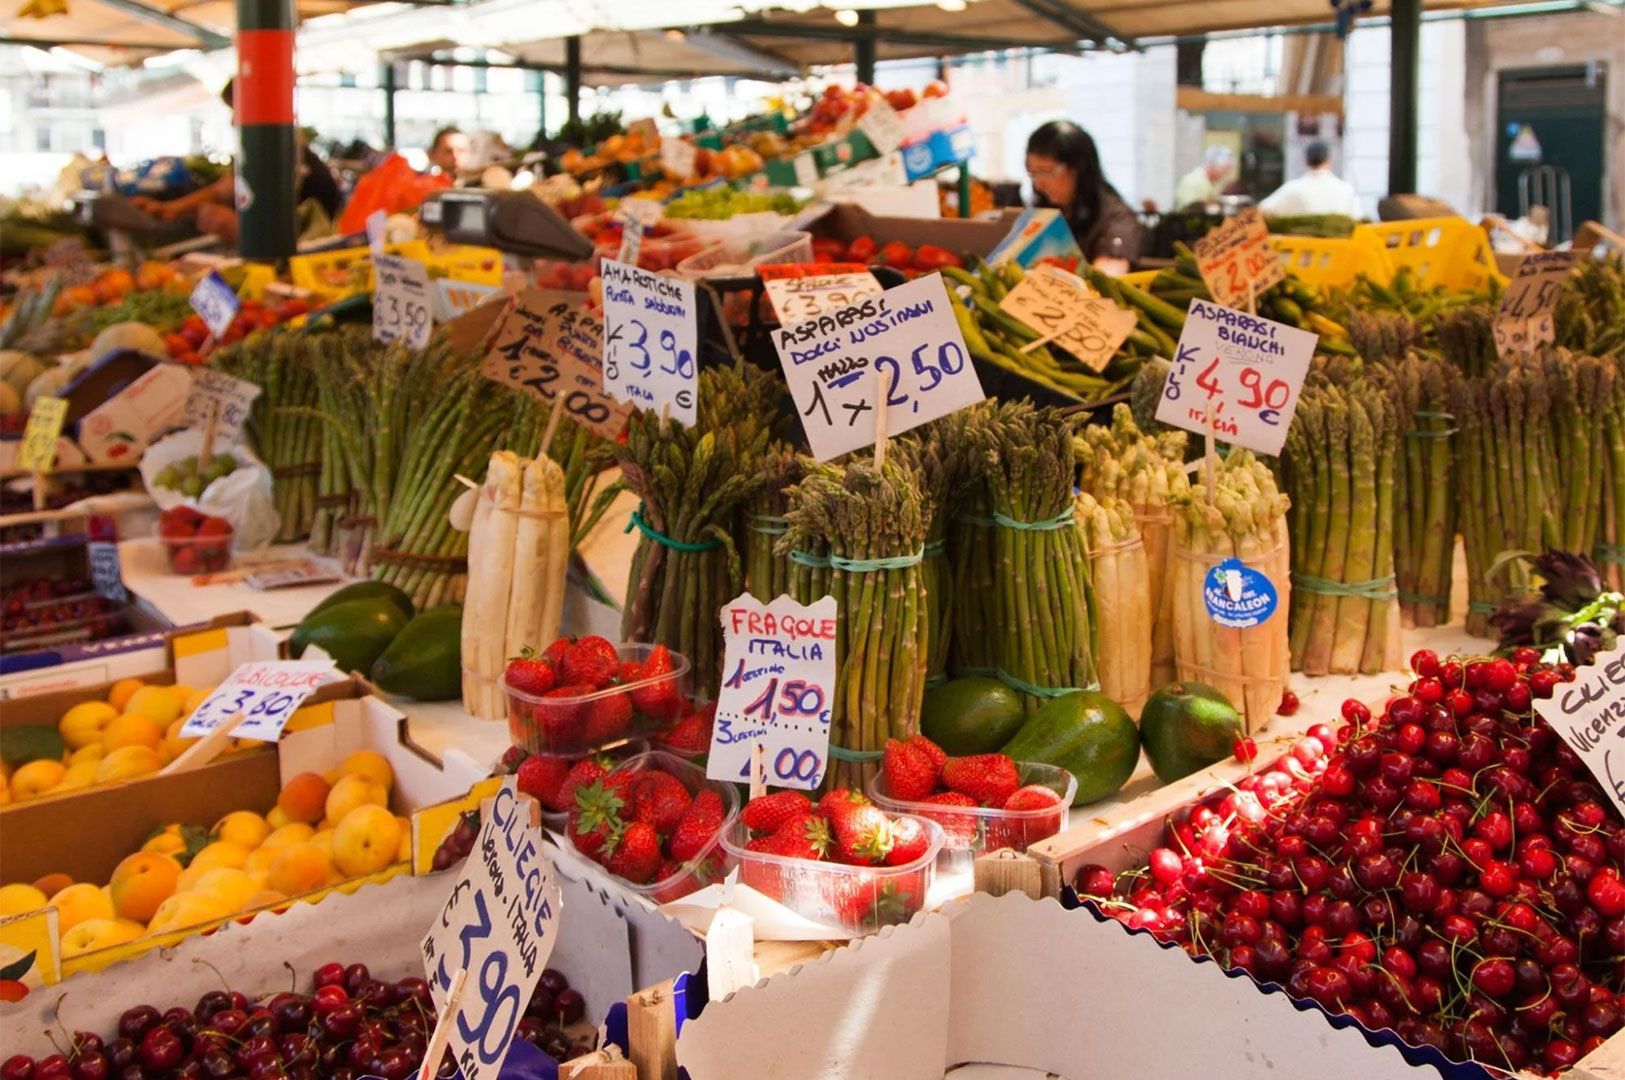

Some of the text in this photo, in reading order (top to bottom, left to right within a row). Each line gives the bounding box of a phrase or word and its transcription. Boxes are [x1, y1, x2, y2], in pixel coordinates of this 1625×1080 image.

[548, 303, 604, 335] ASPA
[781, 298, 886, 350] ASPARAGI
[1191, 303, 1277, 339] ASPARAGI
[1218, 325, 1285, 356] BIANCHI
[629, 319, 694, 409] 3,90 €
[817, 356, 870, 383] MAZZO
[874, 341, 964, 413] 2,50
[1195, 357, 1290, 413] 4,90
[1258, 409, 1281, 426] €
[730, 609, 837, 640] FRAGOLE
[748, 638, 823, 661] ITALIA
[743, 677, 831, 725] 1,50 €
[1560, 653, 1625, 715] CILIE
[1569, 696, 1625, 753] Vicenz
[493, 787, 552, 938] CILIEGIE
[442, 878, 471, 928] €
